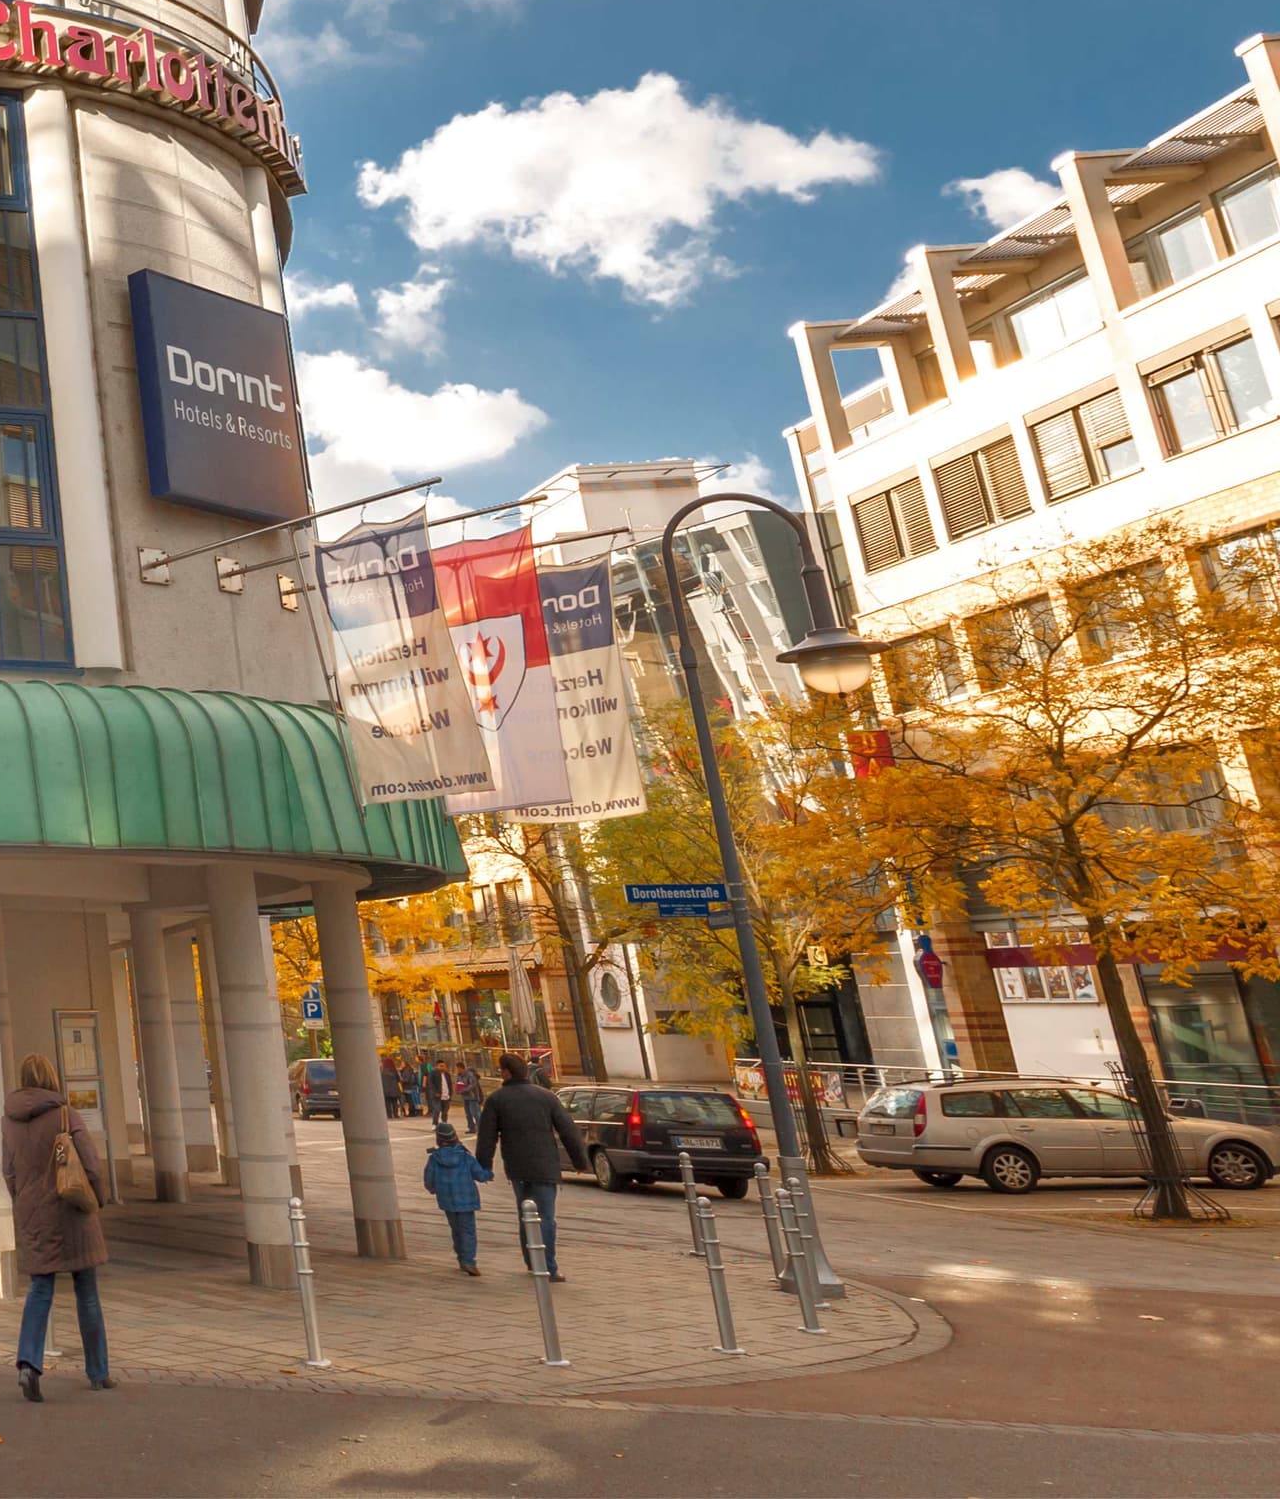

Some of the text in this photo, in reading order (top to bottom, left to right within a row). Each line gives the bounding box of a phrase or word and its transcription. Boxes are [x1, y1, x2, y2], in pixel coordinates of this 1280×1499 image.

[166, 345, 286, 412] Dorint
[173, 398, 293, 450] Hotels & Resorts
[632, 886, 720, 899] Dorotheenstraße
[306, 1003, 318, 1017] P
